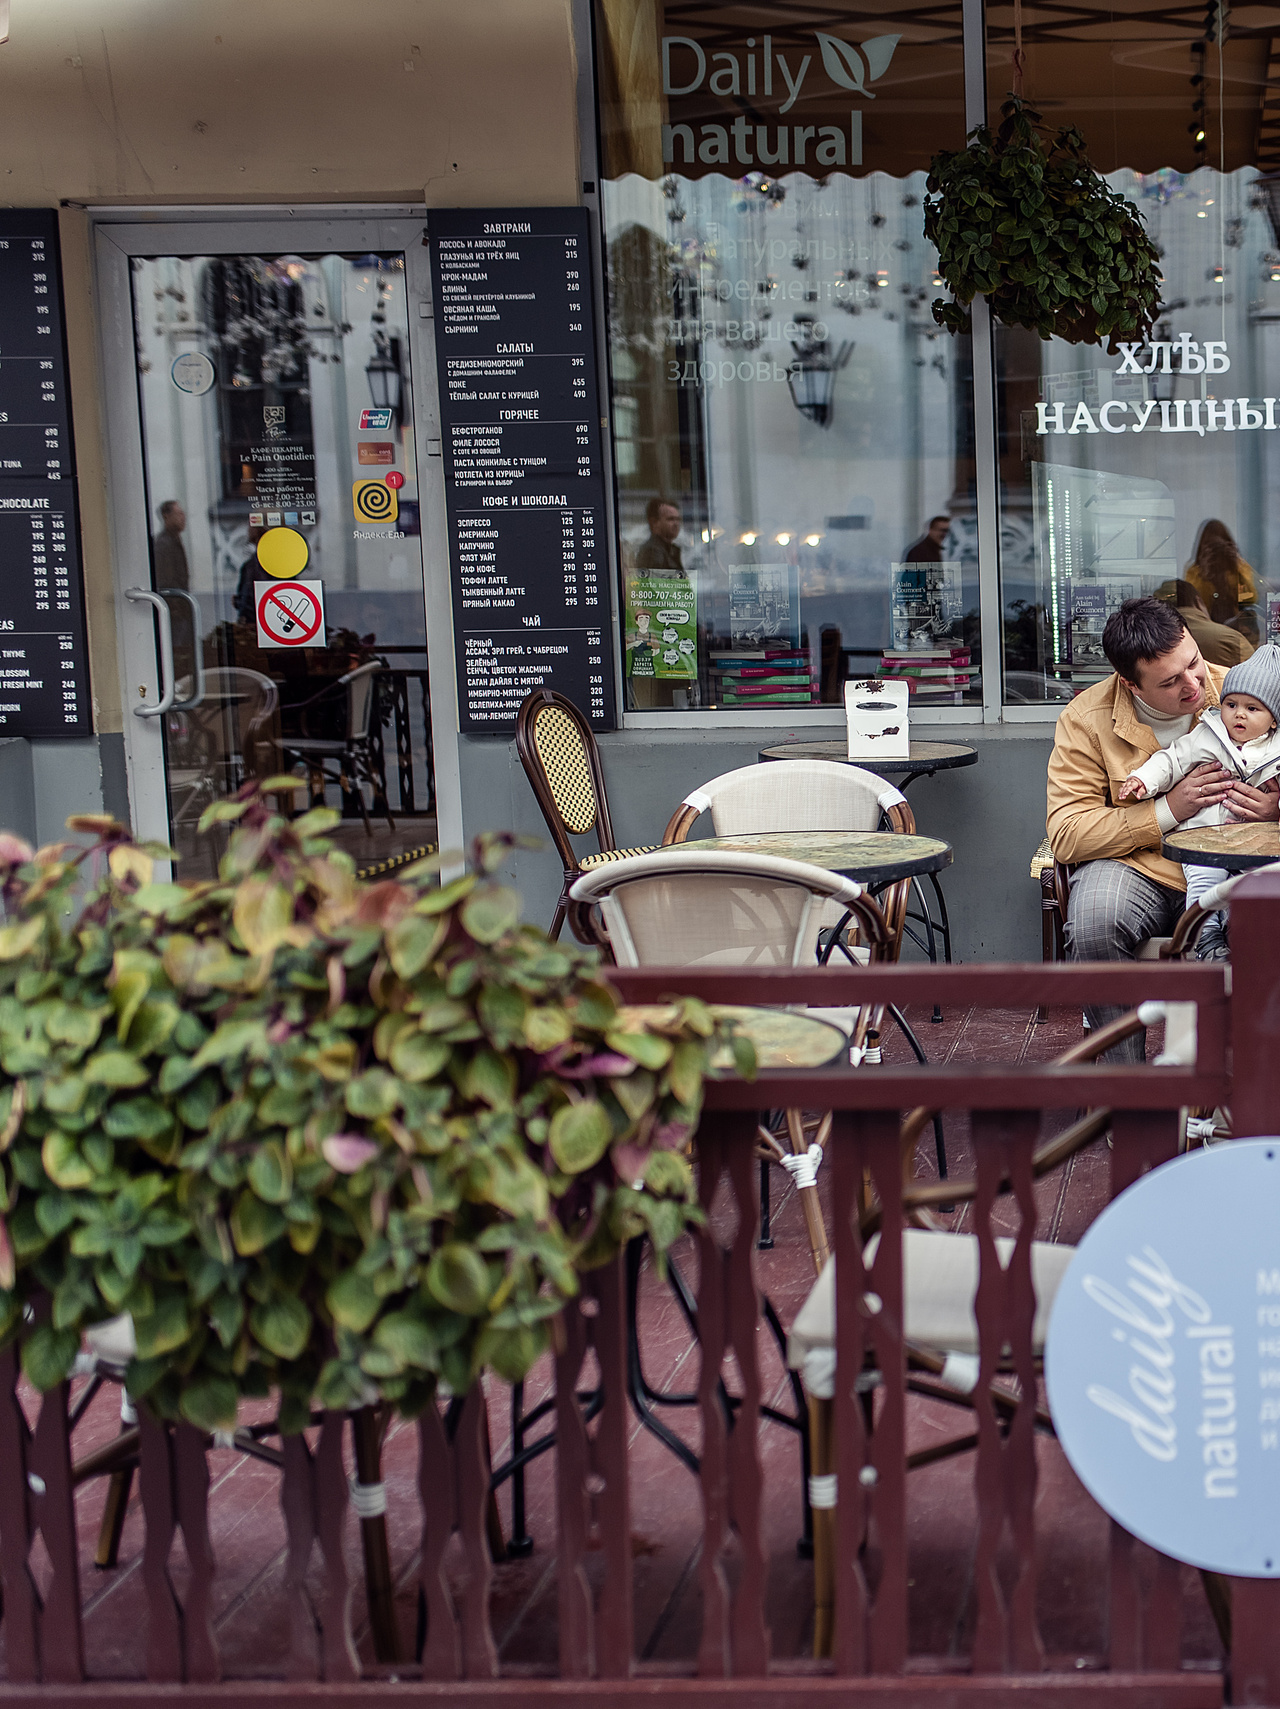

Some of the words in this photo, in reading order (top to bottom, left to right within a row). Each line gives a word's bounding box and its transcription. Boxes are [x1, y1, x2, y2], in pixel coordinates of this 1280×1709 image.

[662, 34, 811, 114] Daily
[662, 110, 862, 165] natural
[484, 223, 531, 233] ЗАВТРАКИ
[439, 241, 465, 249] ЛОСОСЬ
[474, 240, 506, 248] АВОКАДО
[440, 252, 473, 260] ГЛАЗУНЬЯ
[476, 252, 485, 260] ИЗ
[487, 251, 503, 260] ТРЁХ
[506, 252, 520, 260] ЯИЦ
[565, 251, 577, 259] 315
[442, 273, 487, 281] КРОК-МАДАМ
[566, 271, 579, 279] 390
[567, 283, 579, 291] 260
[666, 278, 870, 307] ингредиентов
[476, 305, 496, 313] КАША
[445, 326, 478, 334] СЫРНИКИ
[666, 319, 717, 346] для
[726, 321, 829, 342] вашего
[497, 343, 534, 353] САЛАТЫ
[447, 359, 524, 369] СРЕДИЗЕМНОМОРСКИЙ
[667, 360, 804, 388] здоровья
[449, 392, 477, 400] ТЁПЛЫЙ
[479, 392, 500, 400] САЛАТ
[508, 390, 539, 400] КУРИЦЕЙ
[574, 390, 586, 398] 490
[500, 410, 539, 420] ГОРЯЧЕЕ
[452, 427, 503, 435] БЕФСТРОГАНОВ
[453, 439, 472, 447] ФИЛЕ
[240, 454, 250, 462] Le
[454, 459, 474, 467] ПАСТА
[520, 458, 546, 466] ТУНЦОМ
[455, 471, 483, 479] КОТЛЕТА
[496, 470, 524, 478] КУРИЦЫ
[392, 476, 397, 484] 1
[277, 485, 304, 493] работы
[0, 499, 50, 508] CHOCOLATE
[482, 496, 508, 507] КОФЕ
[512, 496, 518, 506] И
[522, 495, 567, 506] ШОКОЛАД
[458, 519, 491, 527] ЭСПРЕССО
[562, 517, 573, 525] 125
[459, 542, 494, 550] КАПУЧИНО
[631, 590, 694, 600] 8-800-707-45-60
[522, 615, 541, 627] ЧАЙ
[465, 638, 492, 648] ЧЁРНЫЙ
[3, 681, 25, 689] FRESH
[469, 700, 523, 709] ОБЛЕПИХА-ИМБ
[1082, 1245, 1212, 1462] daily
[1185, 1325, 1238, 1498] natural
[1261, 1430, 1277, 1450] и
